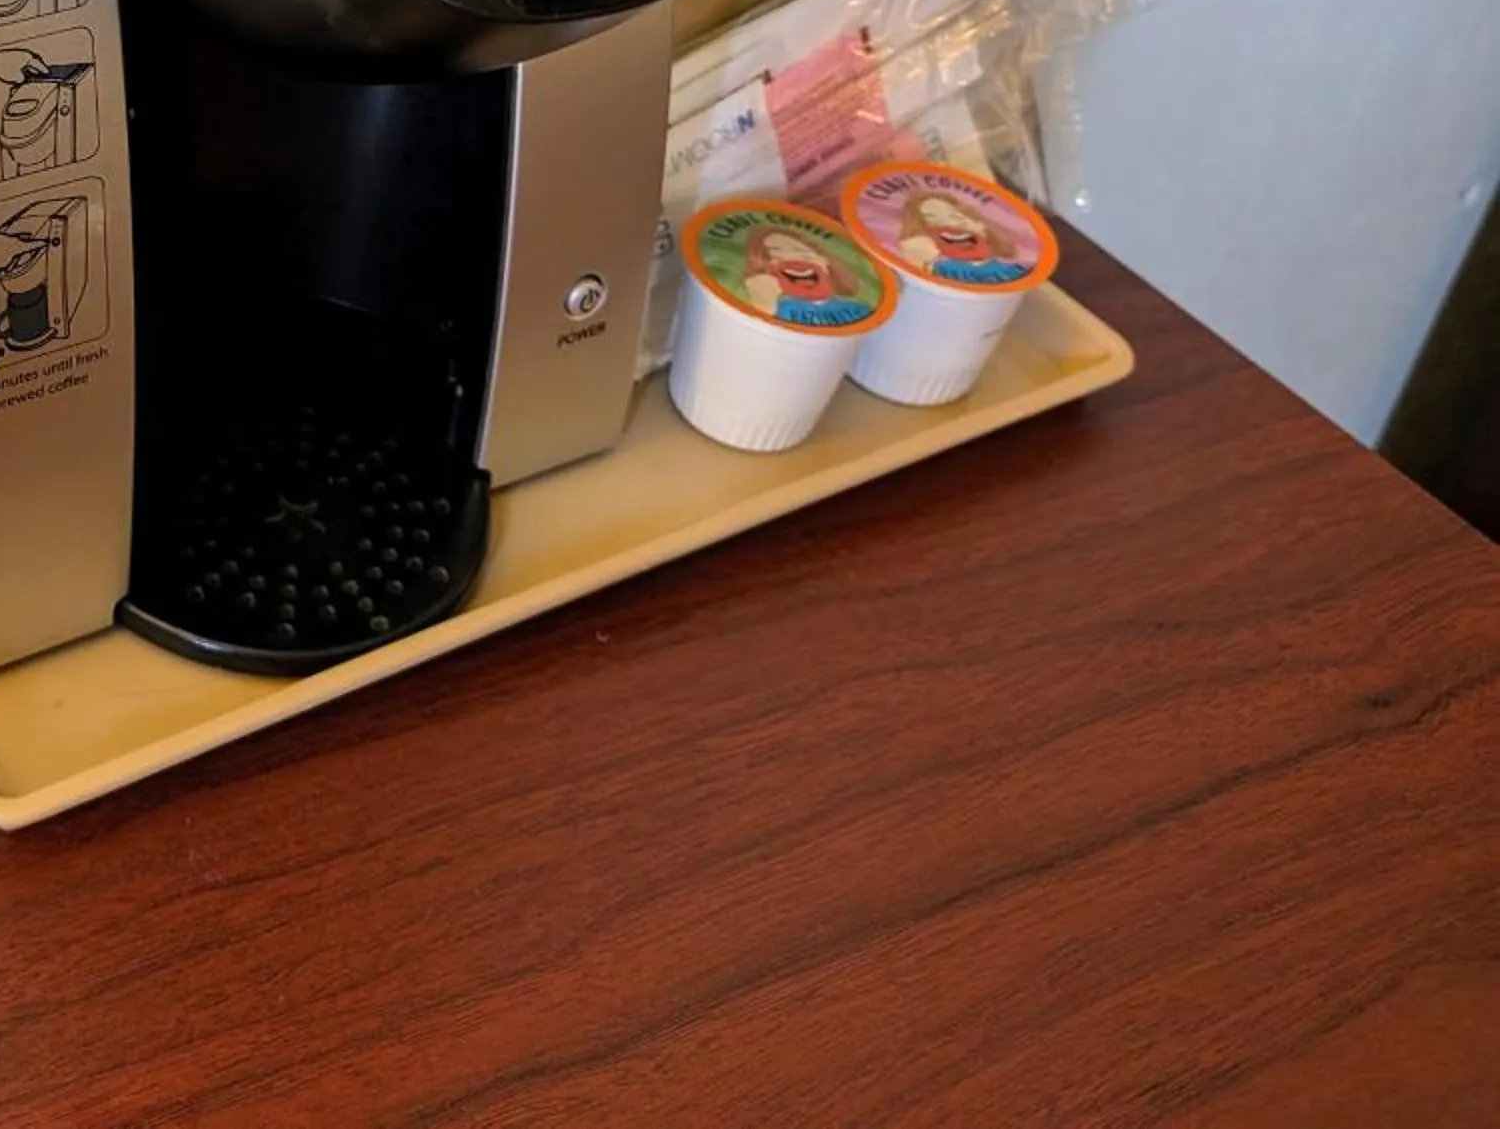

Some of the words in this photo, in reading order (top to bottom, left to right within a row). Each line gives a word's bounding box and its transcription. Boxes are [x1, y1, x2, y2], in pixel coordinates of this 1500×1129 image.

[557, 321, 606, 349] POWER
[42, 355, 74, 377] until
[75, 346, 110, 369] fresh
[47, 372, 90, 395] coffee
